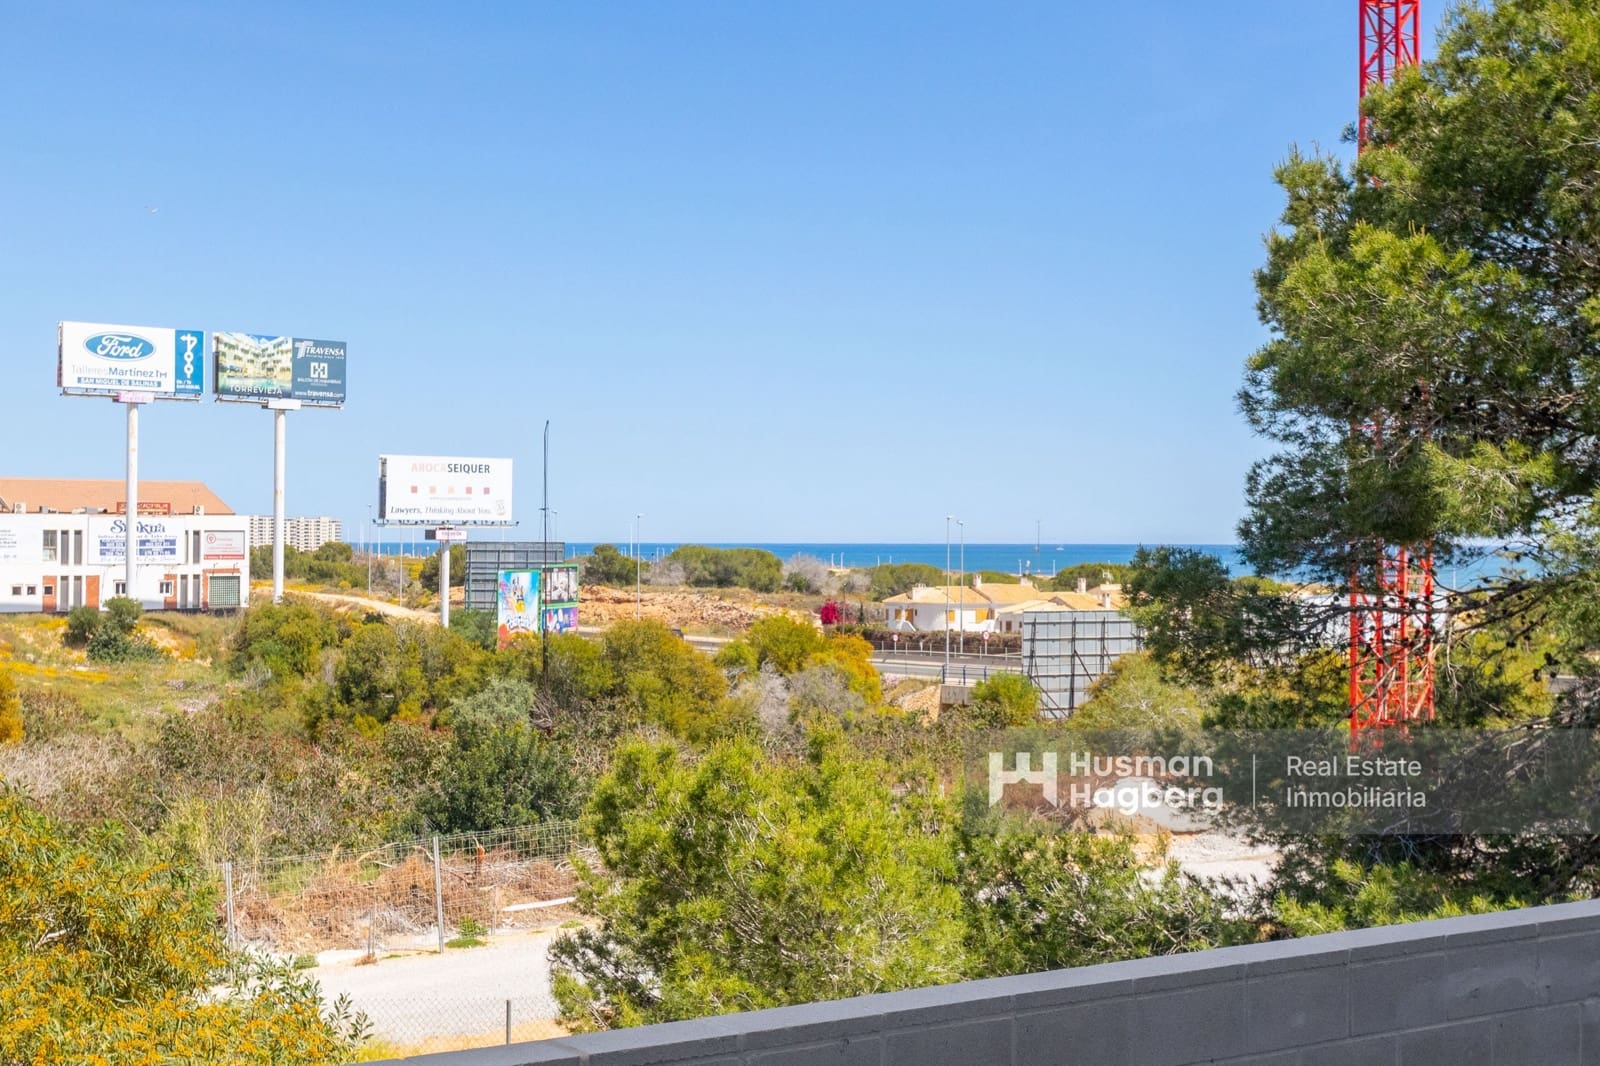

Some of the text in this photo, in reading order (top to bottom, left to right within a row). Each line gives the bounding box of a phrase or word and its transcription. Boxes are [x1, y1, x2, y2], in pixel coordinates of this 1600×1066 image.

[96, 335, 144, 358] Ford
[306, 346, 344, 357] TRAVENSA
[230, 384, 282, 395] TORREVIEJA
